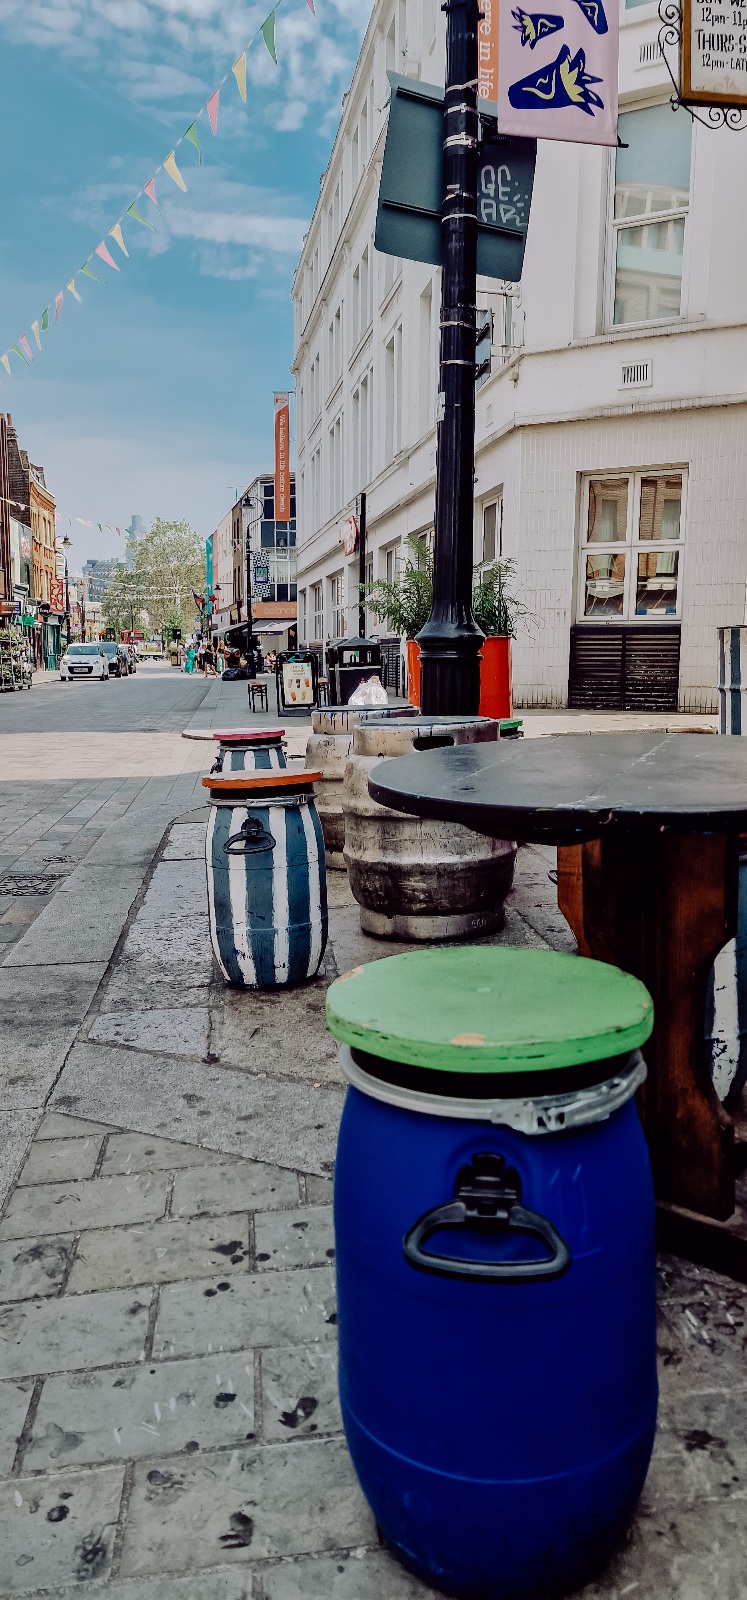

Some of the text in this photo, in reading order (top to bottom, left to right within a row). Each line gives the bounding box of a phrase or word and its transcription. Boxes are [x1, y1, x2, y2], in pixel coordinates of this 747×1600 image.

[480, 41, 495, 61] in
[479, 66, 494, 99] life
[280, 414, 286, 426] We
[264, 607, 296, 615] balance
